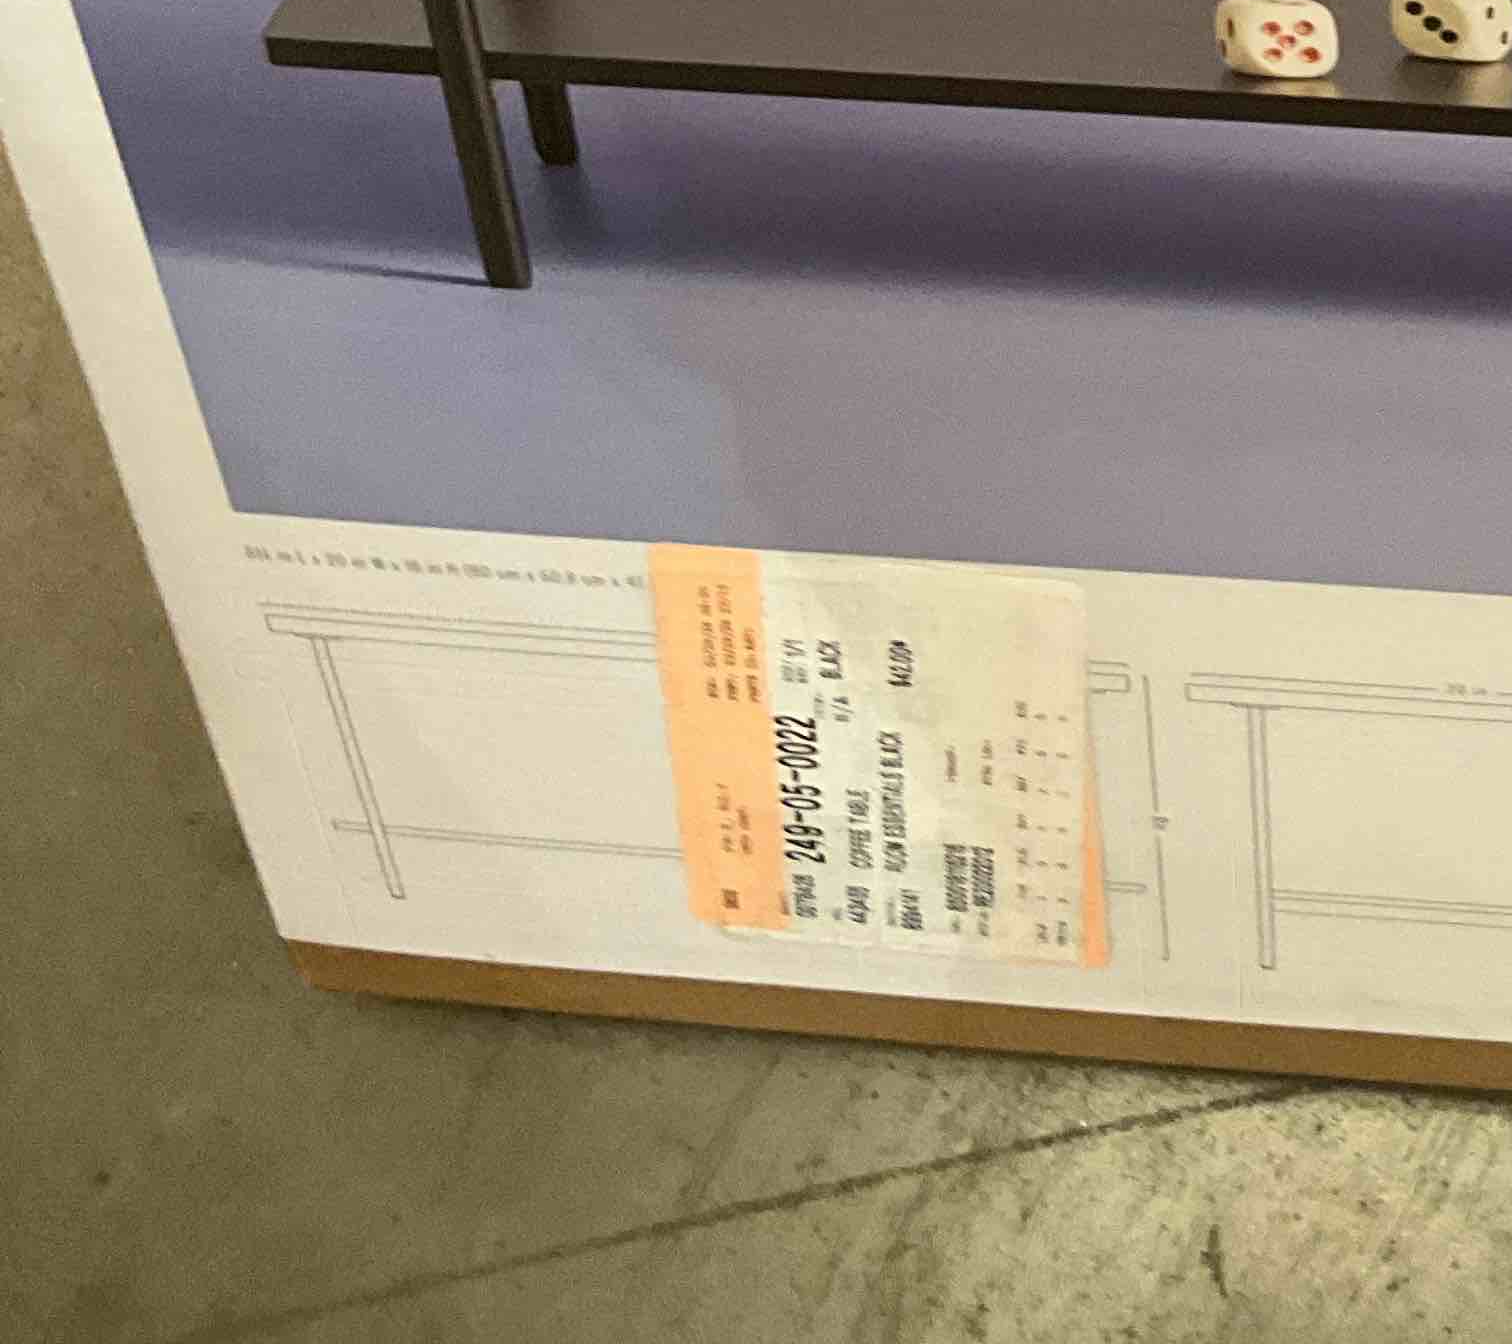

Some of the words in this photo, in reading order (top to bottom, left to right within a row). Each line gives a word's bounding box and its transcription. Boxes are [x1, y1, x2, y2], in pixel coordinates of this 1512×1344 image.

[816, 639, 843, 680] BLACK
[878, 729, 905, 769] BLACK
[773, 713, 825, 864] 249-05-0022
[844, 787, 870, 824] TABLE
[847, 827, 873, 870] COFFEE
